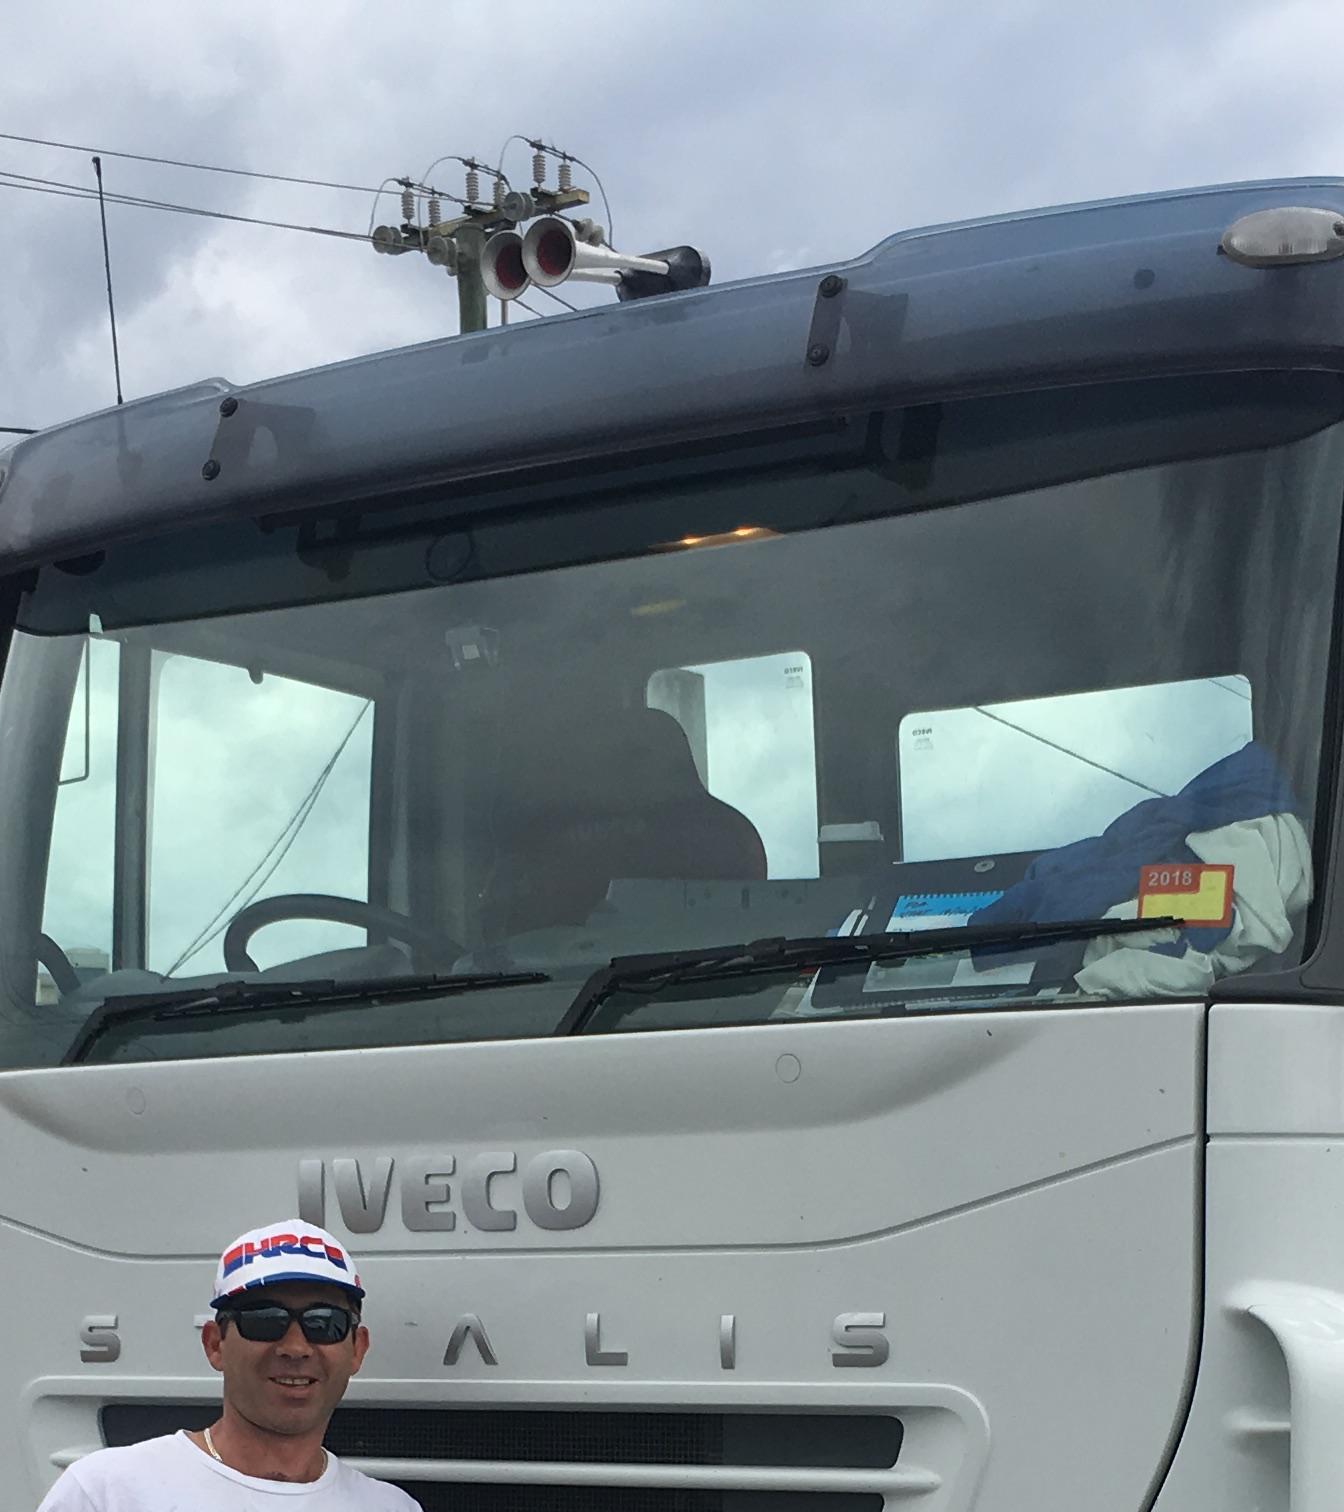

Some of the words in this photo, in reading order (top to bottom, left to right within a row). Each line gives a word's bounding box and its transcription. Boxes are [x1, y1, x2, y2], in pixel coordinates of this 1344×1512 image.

[1148, 871, 1192, 887] 2018
[298, 1150, 600, 1234] IVECO
[241, 1233, 327, 1266] HRC
[80, 1311, 890, 1369] SALIS
